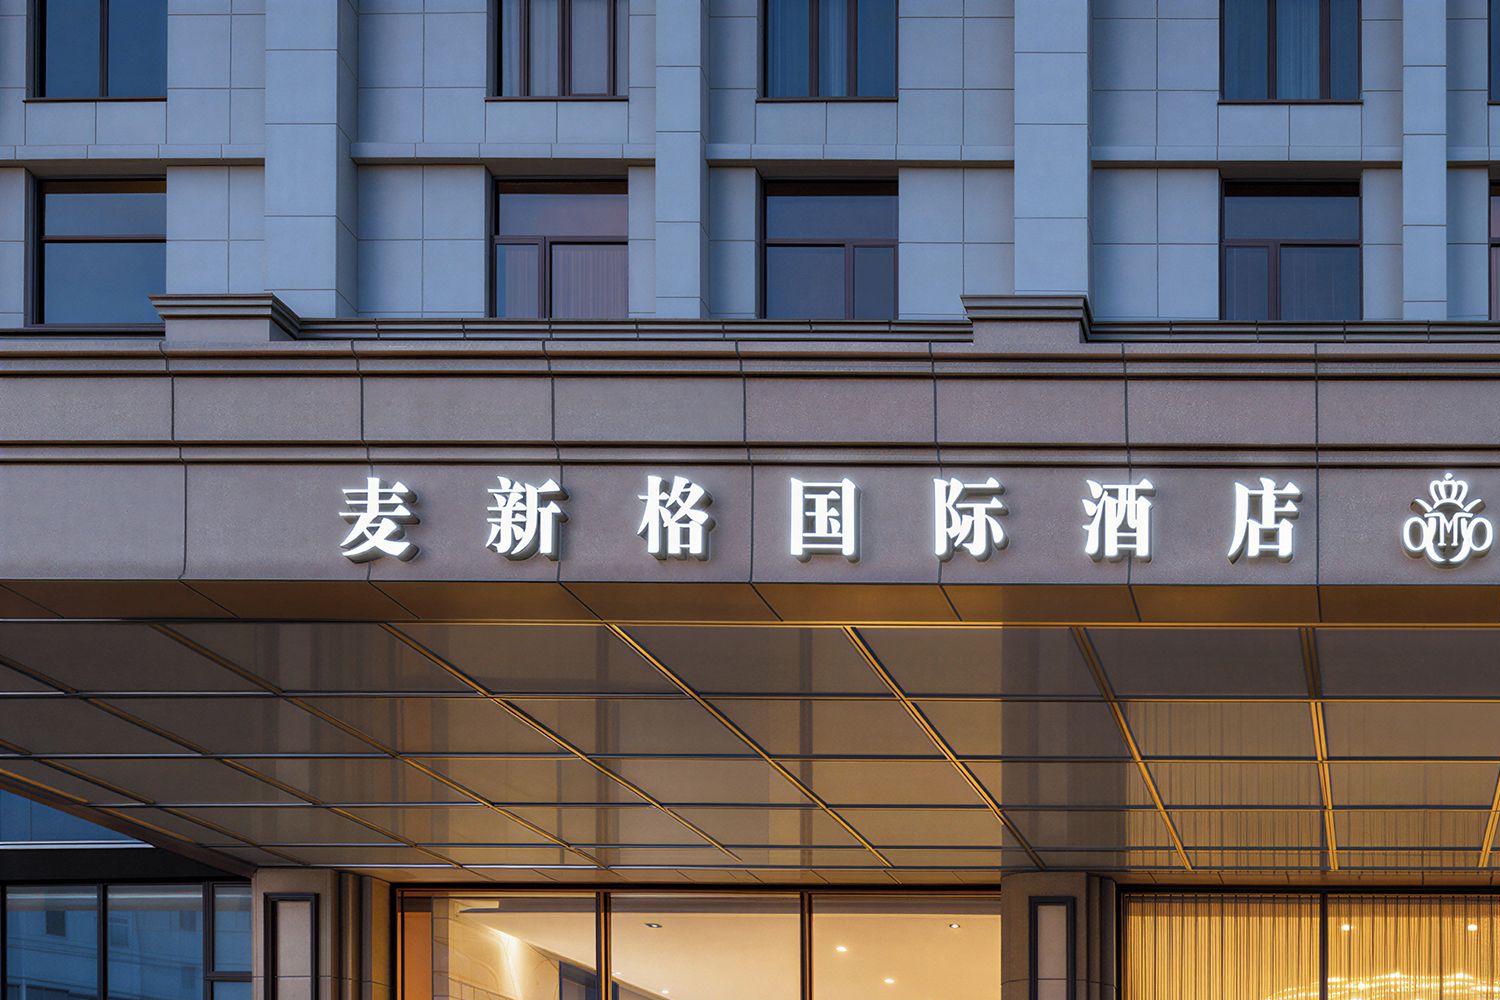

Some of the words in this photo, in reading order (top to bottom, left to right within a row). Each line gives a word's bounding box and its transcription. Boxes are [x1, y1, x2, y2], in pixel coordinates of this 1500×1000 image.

[338, 474, 1301, 558] 麦新格国际酒店
